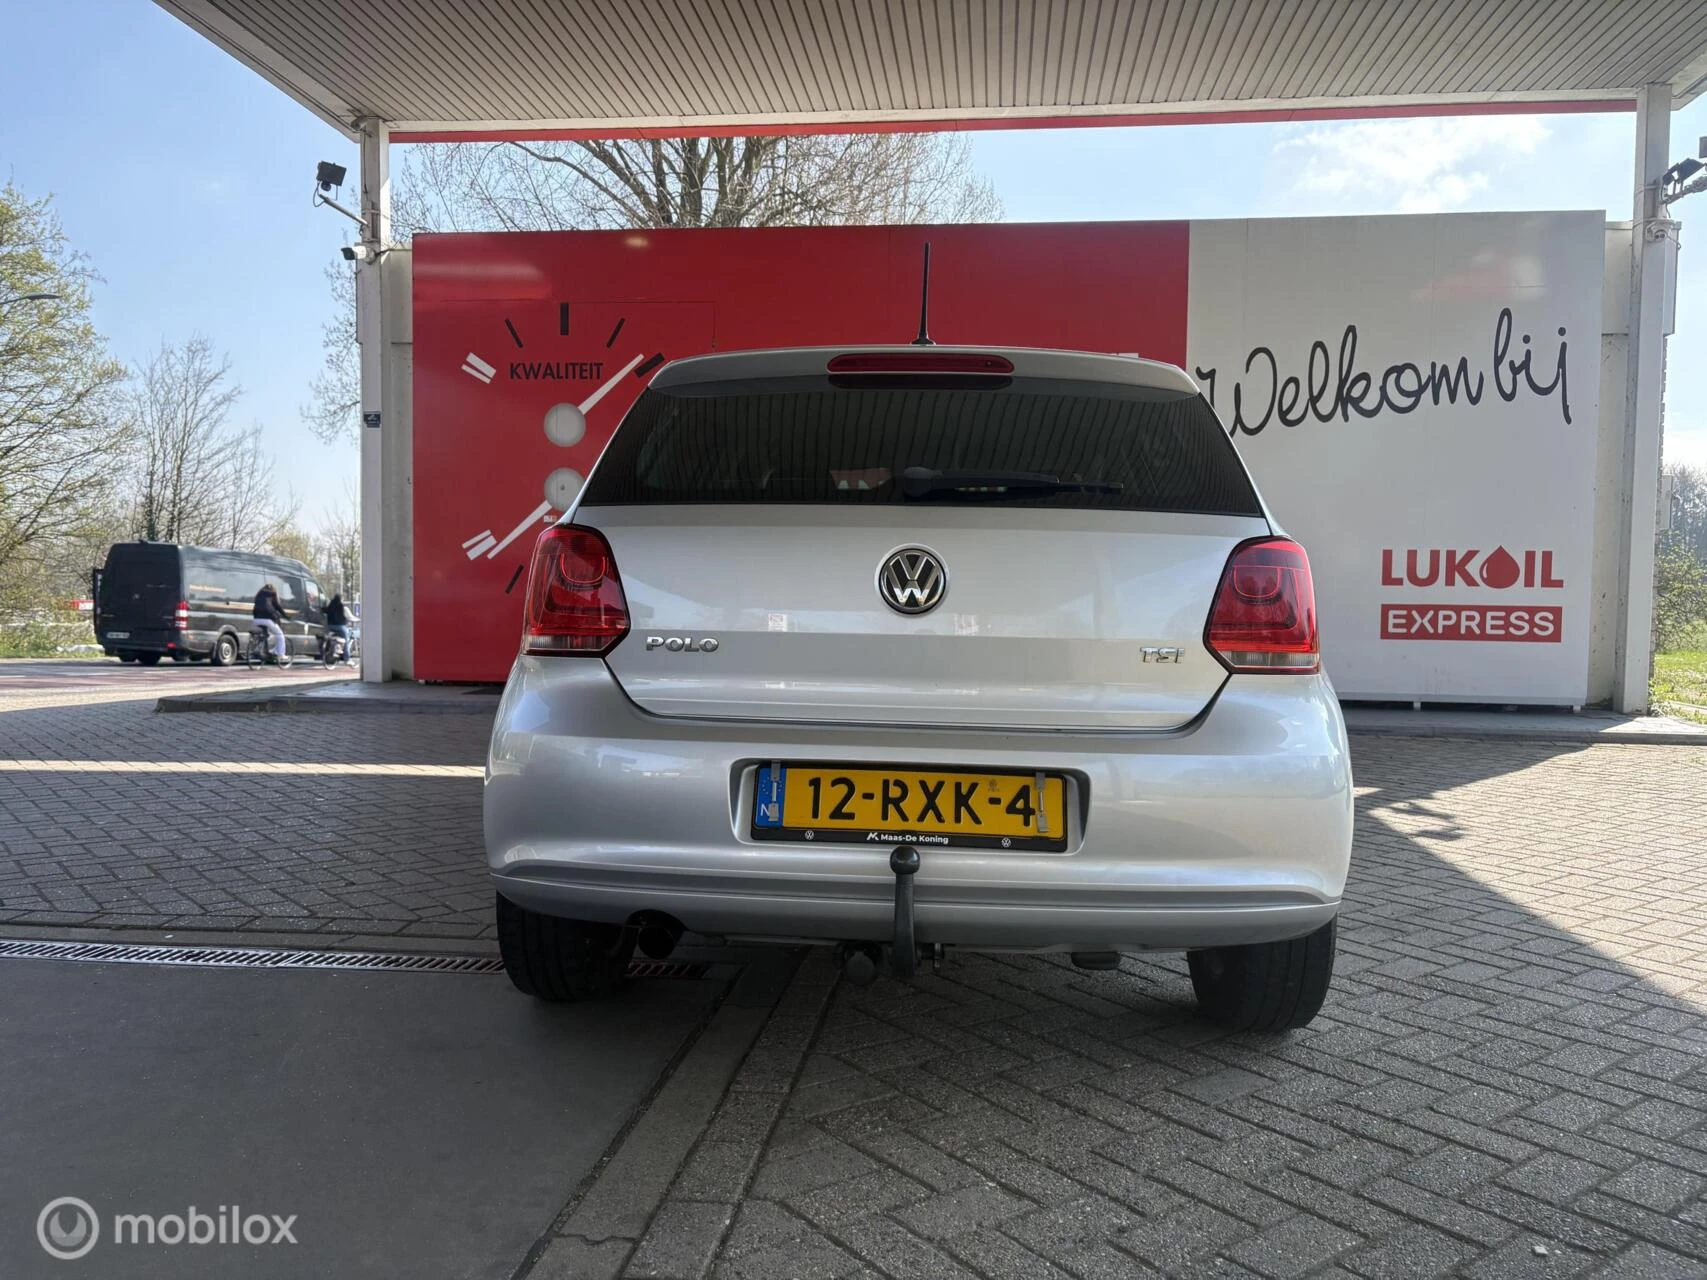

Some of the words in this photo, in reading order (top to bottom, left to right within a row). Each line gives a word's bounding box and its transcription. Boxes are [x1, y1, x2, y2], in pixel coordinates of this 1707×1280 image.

[510, 362, 604, 381] KWALITEIT
[1196, 324, 1485, 437] Welkom
[1493, 307, 1573, 425] bij
[1381, 545, 1564, 589] LUKOIL
[1387, 609, 1556, 636] EXPRESS
[646, 636, 719, 653] POLO
[1140, 646, 1186, 664] TSI
[807, 776, 1036, 828] 12-RXK-4
[880, 833, 917, 842] Maas-De
[918, 835, 949, 845] Koning
